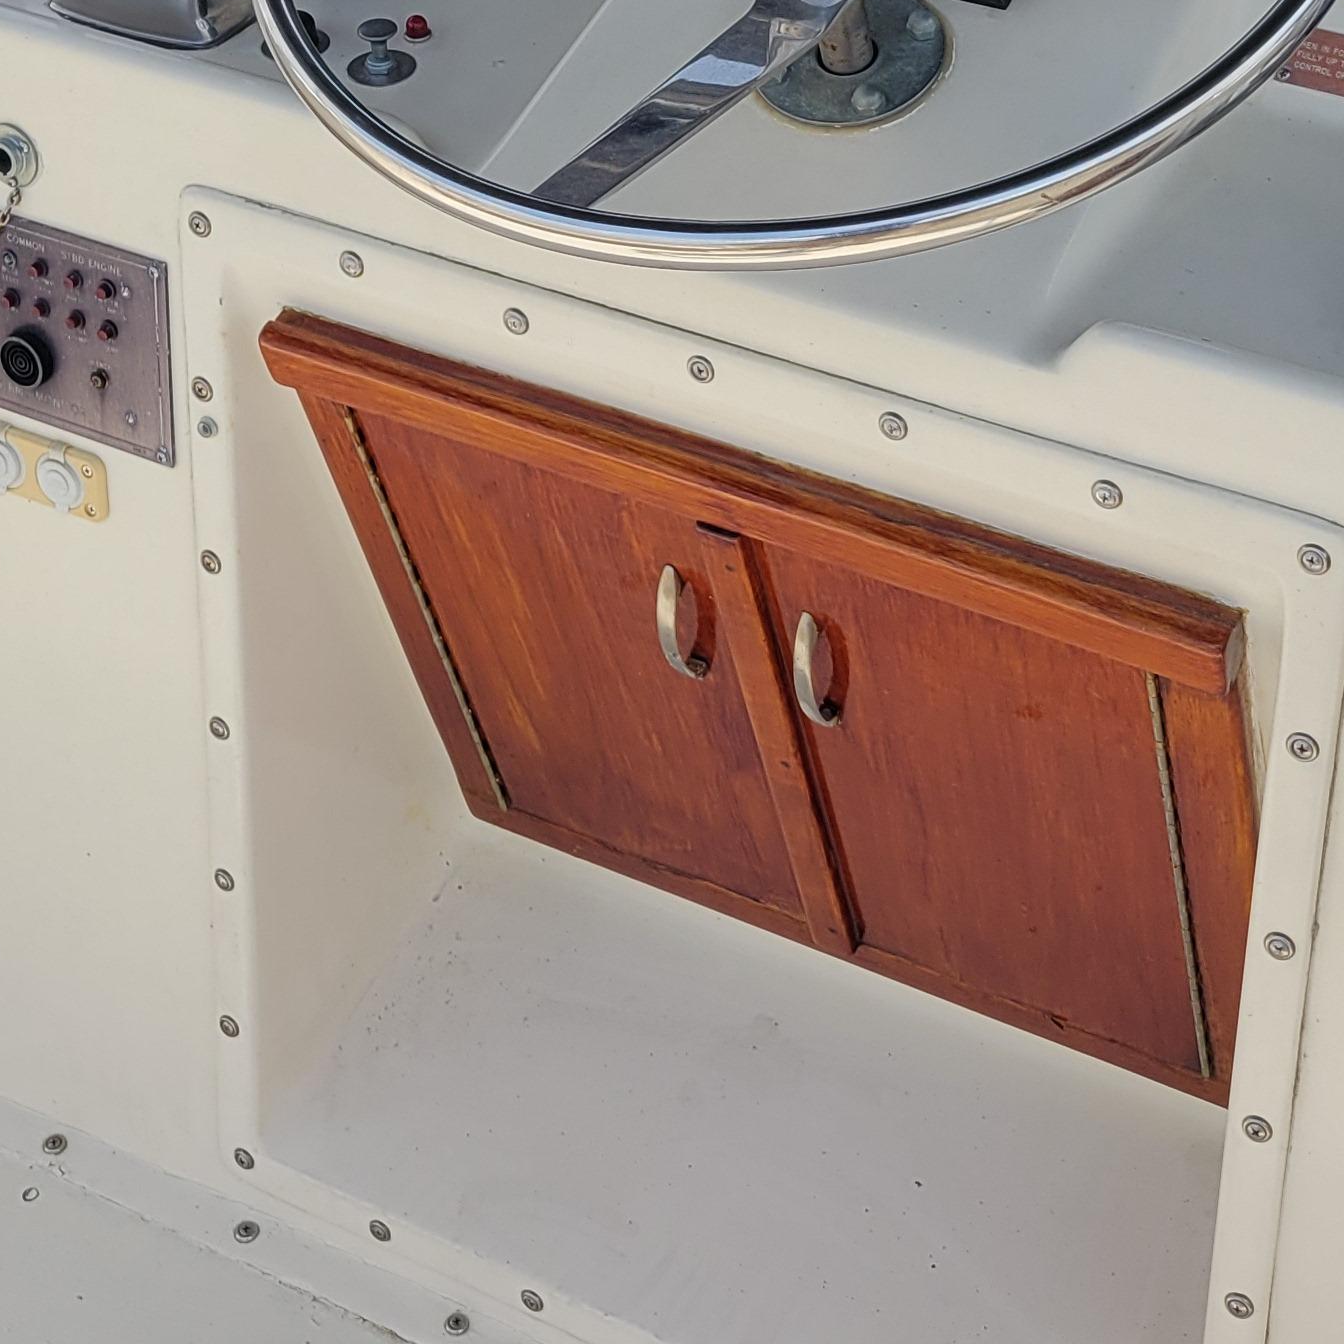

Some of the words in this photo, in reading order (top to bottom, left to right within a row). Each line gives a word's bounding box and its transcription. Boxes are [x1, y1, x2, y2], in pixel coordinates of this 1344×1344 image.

[1296, 50, 1323, 62] FULLY
[1325, 57, 1338, 65] UP
[1293, 61, 1332, 77] CONTROL
[6, 234, 45, 253] COMMON
